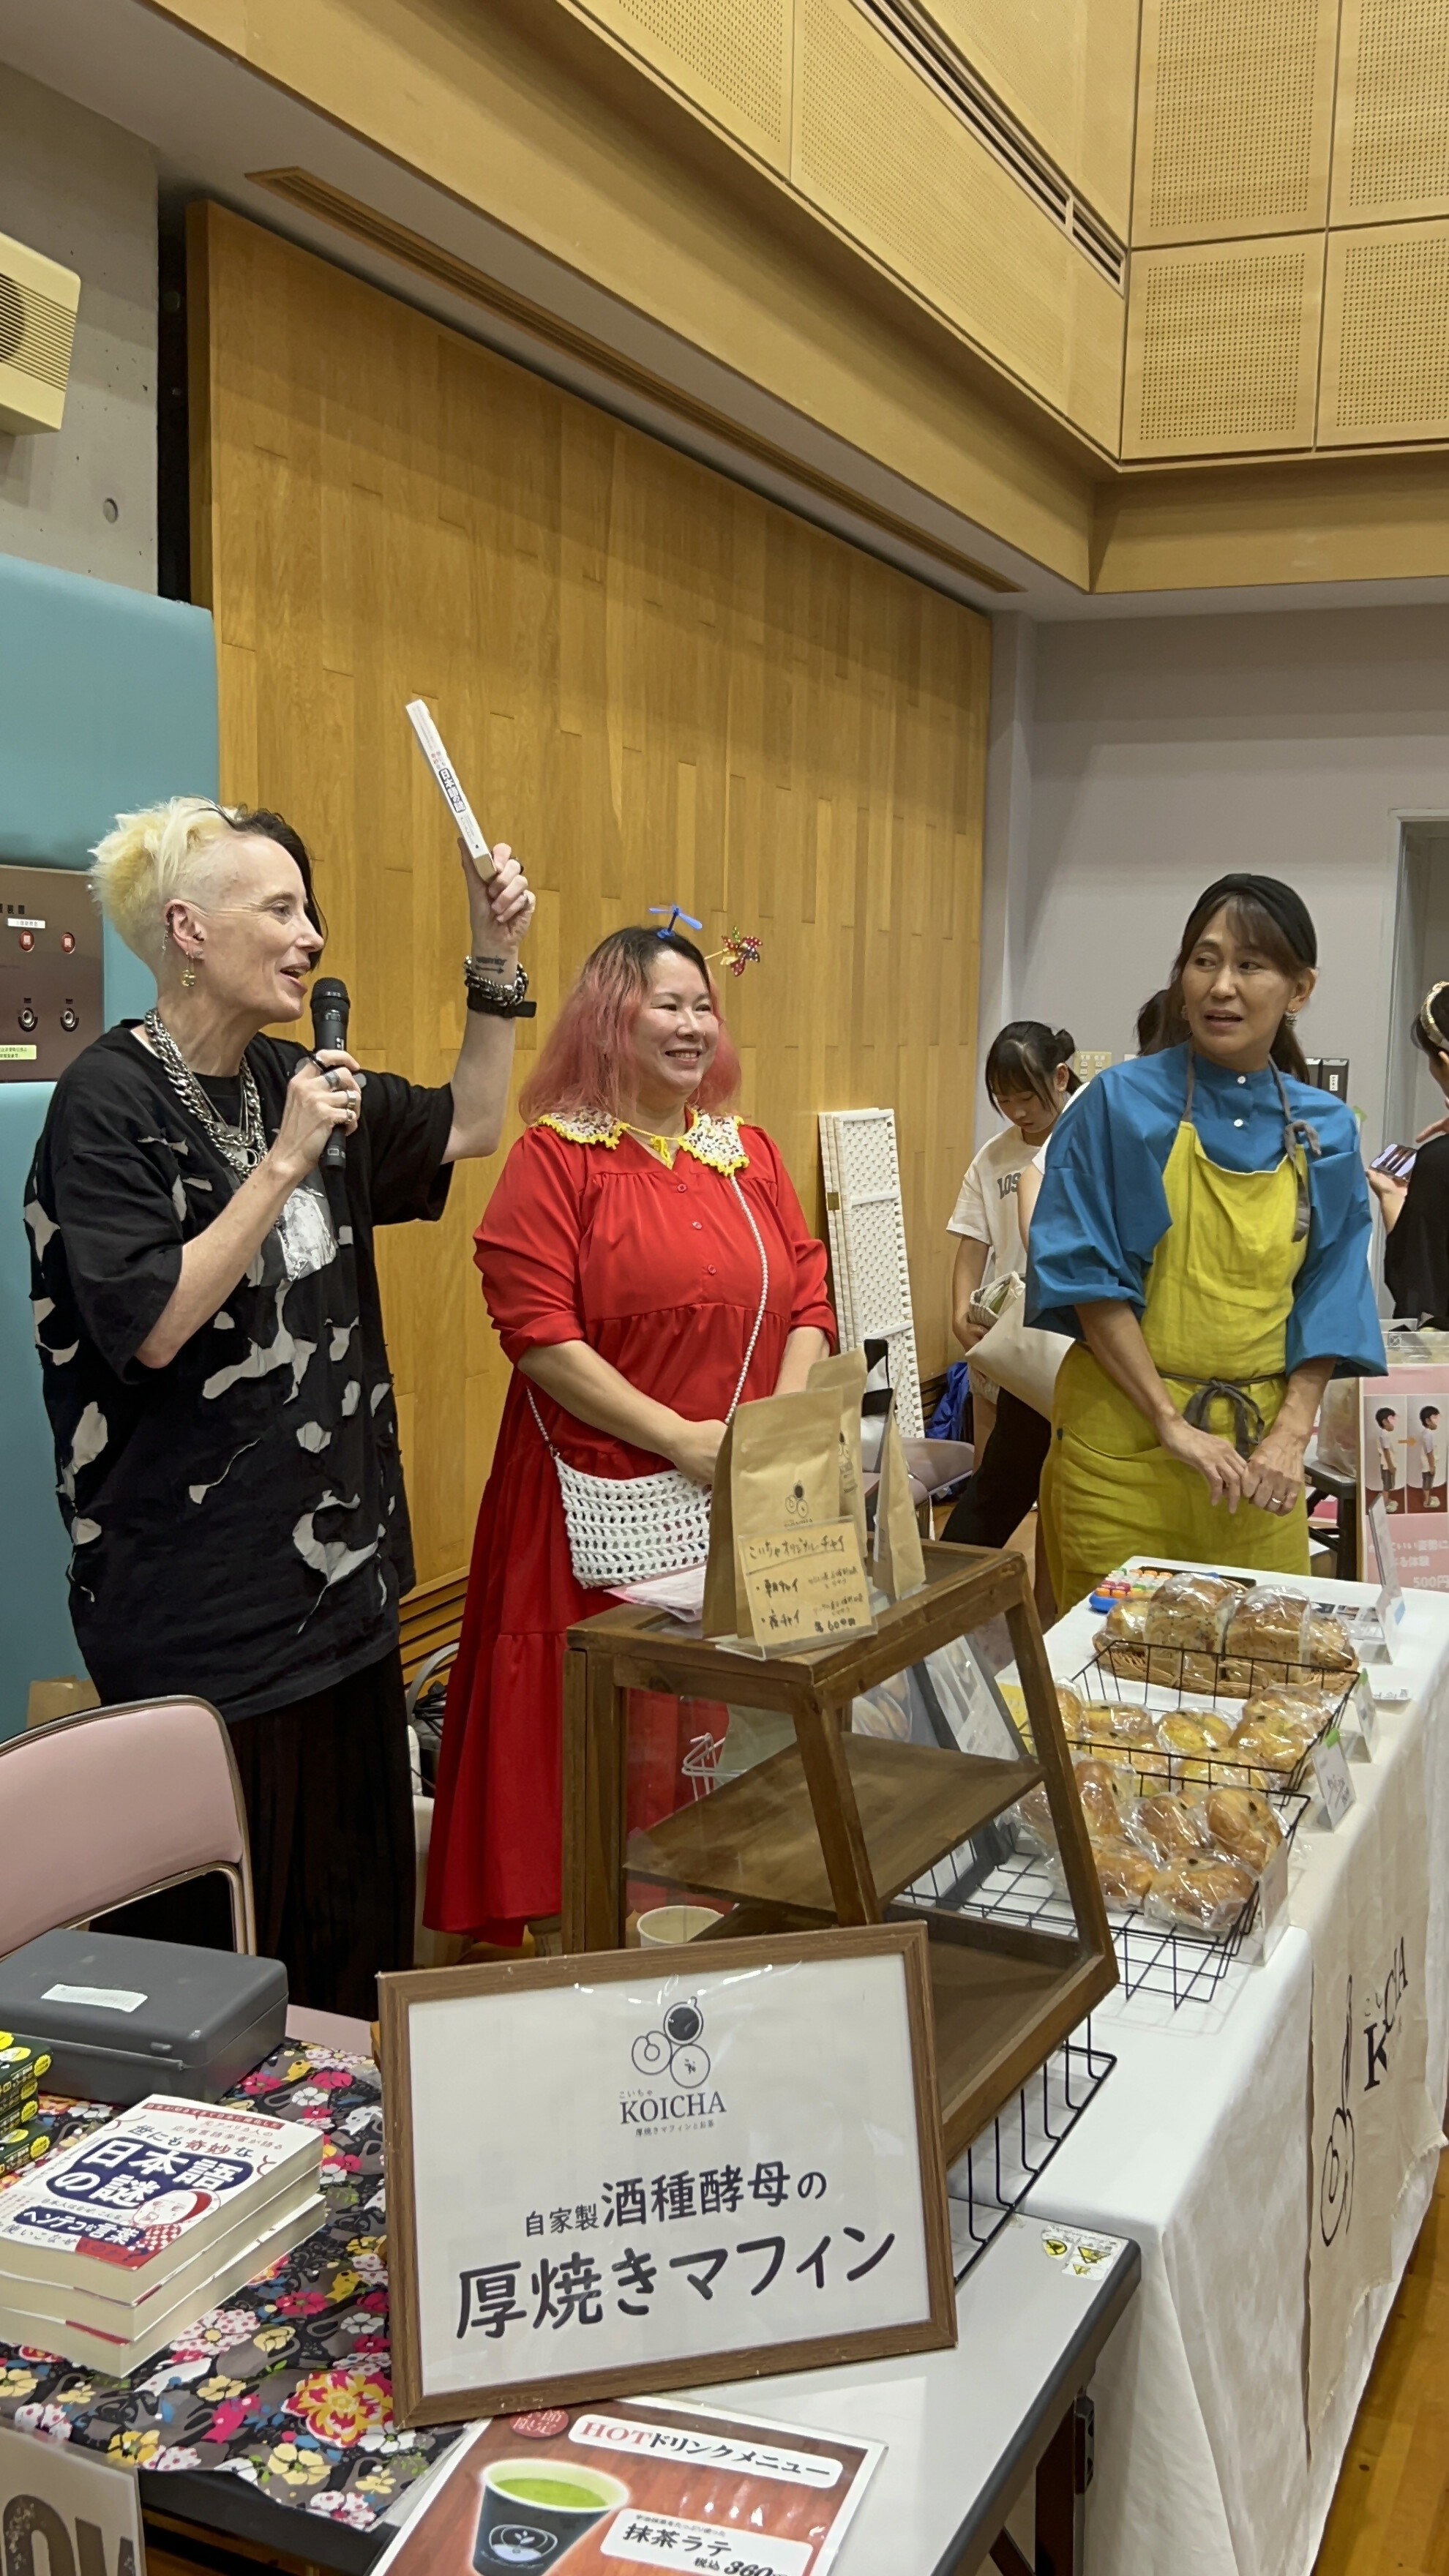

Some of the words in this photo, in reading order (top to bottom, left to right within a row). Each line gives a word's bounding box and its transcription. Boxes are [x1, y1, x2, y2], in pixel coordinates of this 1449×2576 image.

[619, 2089, 653, 2100] こいちゃ
[620, 2091, 727, 2124] KOICHA
[128, 2124, 254, 2158] 世にも奇妙な
[82, 2139, 244, 2190] 日本語
[54, 2171, 161, 2208] の謎
[525, 2160, 827, 2237] 自家製酒種酵母の
[23, 2210, 140, 2246] ヘンテコな言葉
[457, 2226, 896, 2340] 厚焼きマフィン
[580, 2421, 831, 2475] HOTドリンクメニュー
[622, 2523, 732, 2557] 抹茶ラテ
[694, 2557, 720, 2571] 税込
[724, 2561, 788, 2576] 360
